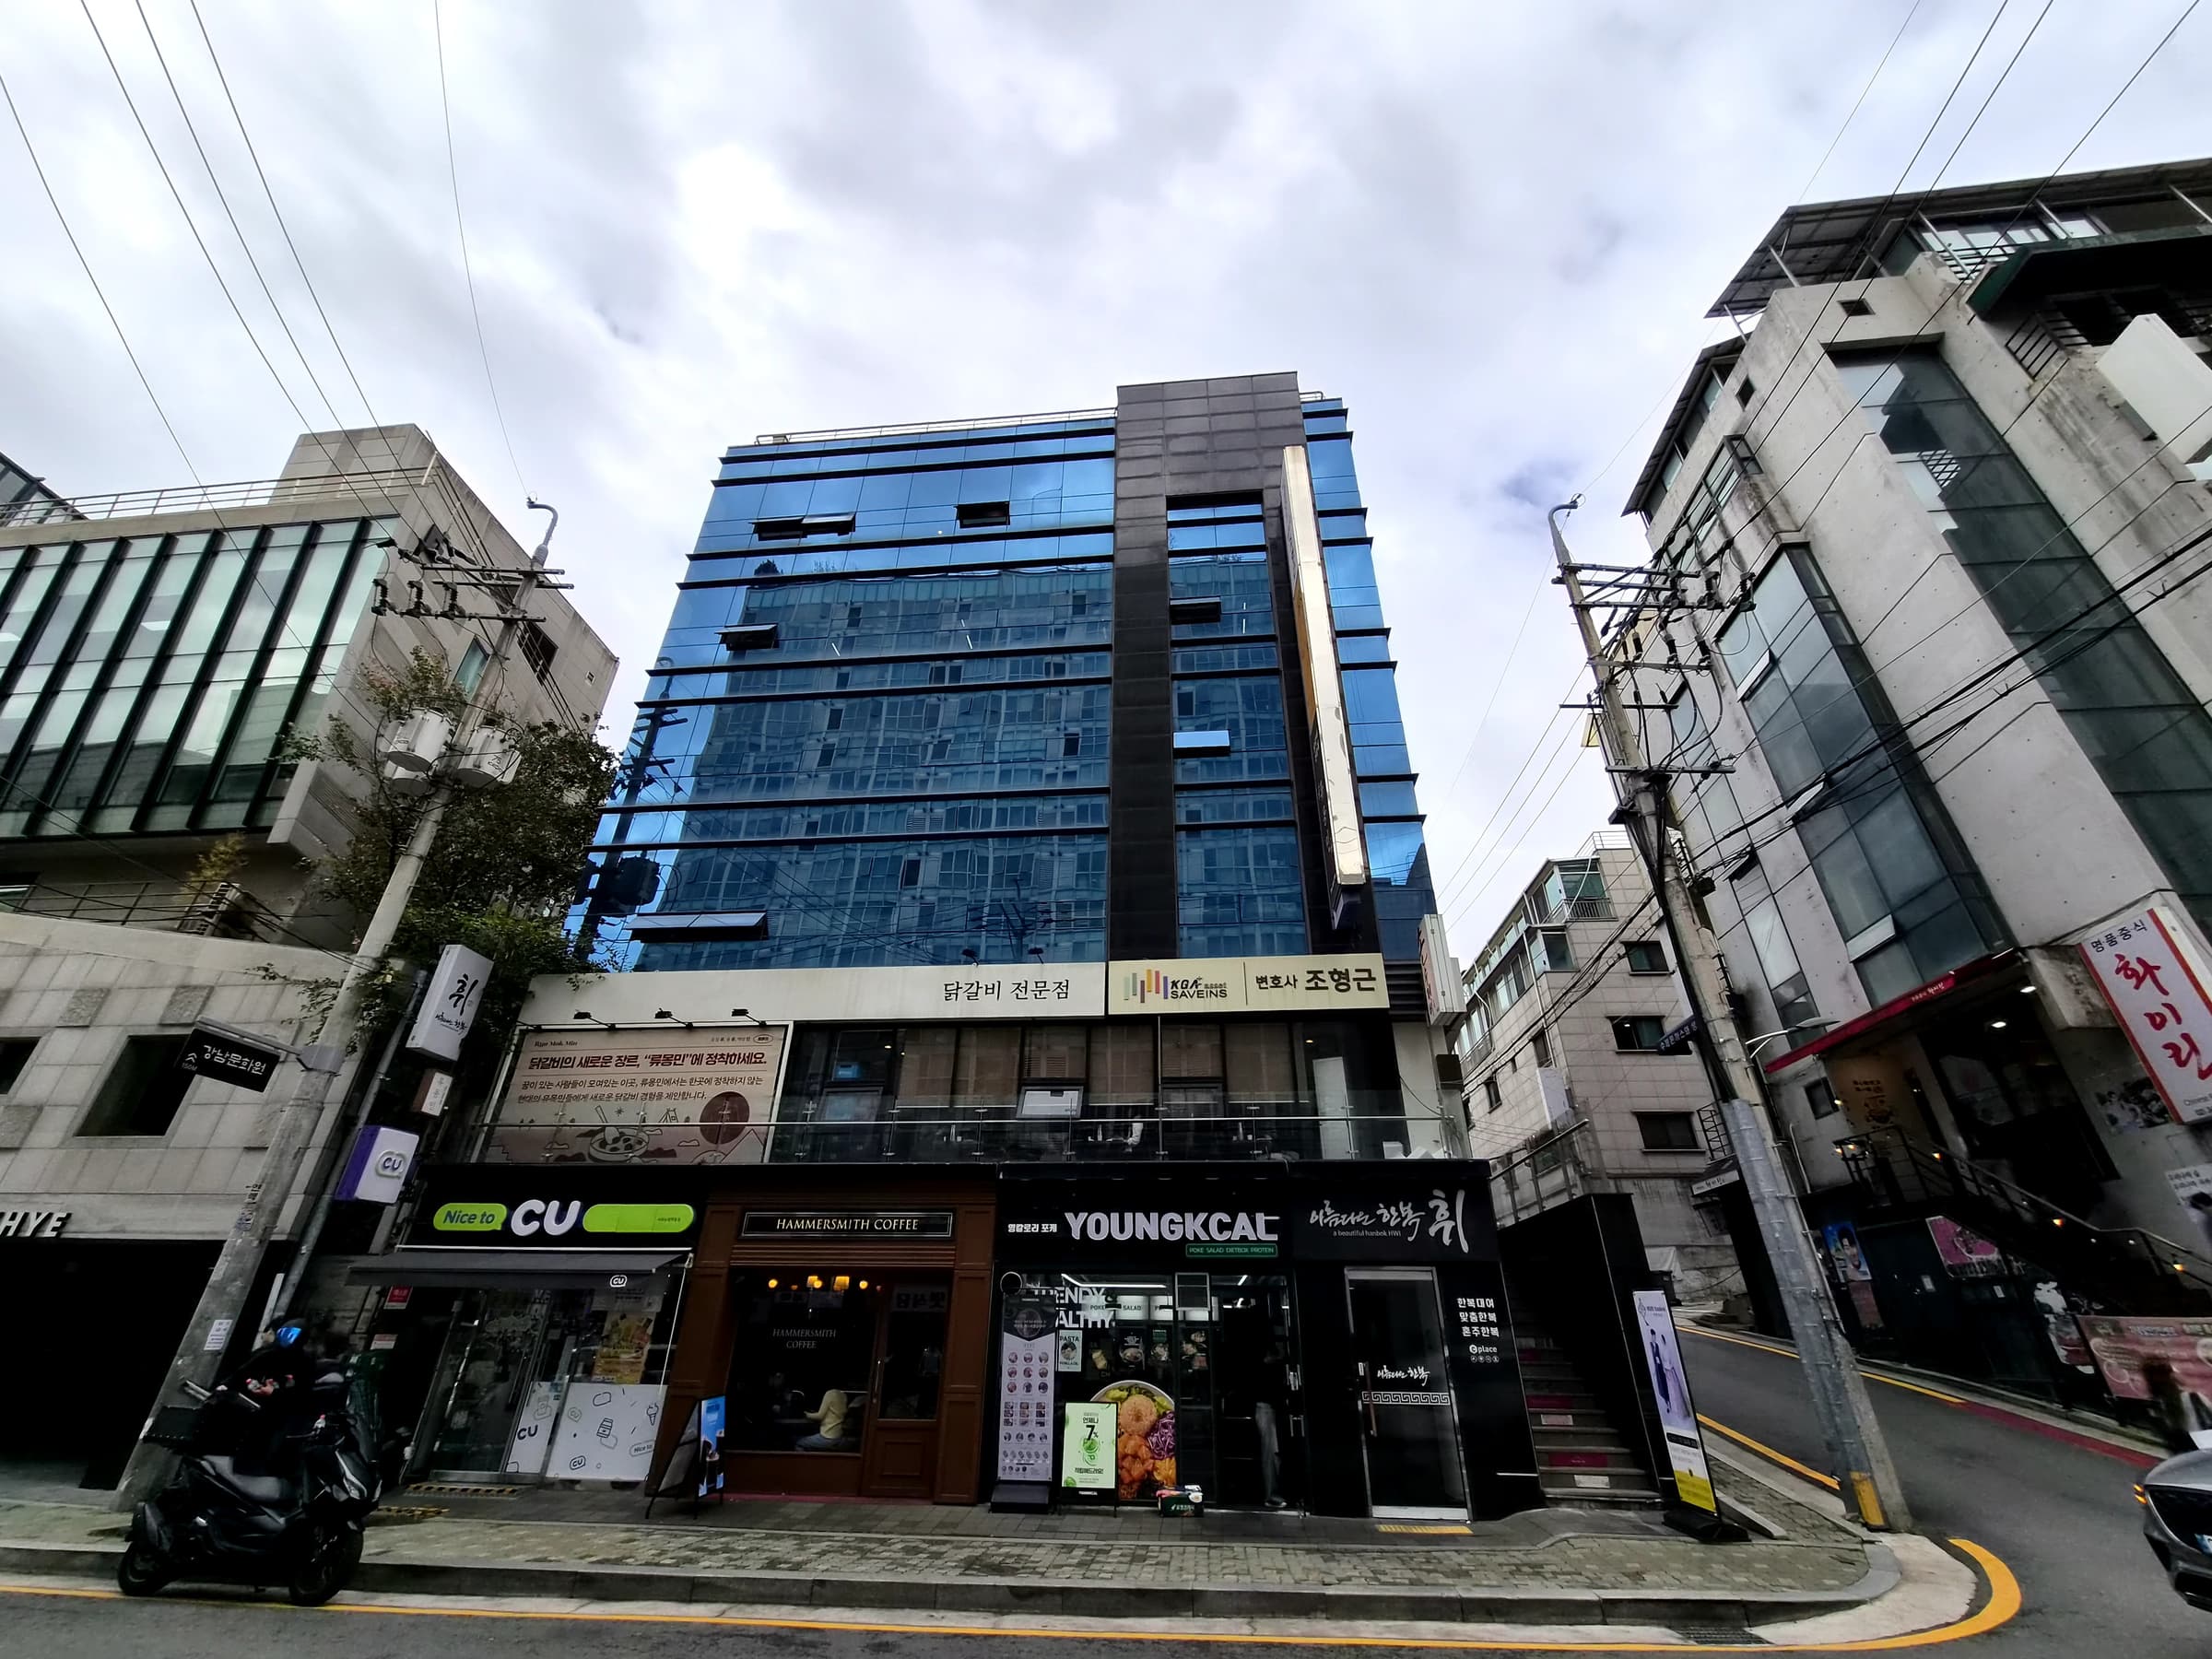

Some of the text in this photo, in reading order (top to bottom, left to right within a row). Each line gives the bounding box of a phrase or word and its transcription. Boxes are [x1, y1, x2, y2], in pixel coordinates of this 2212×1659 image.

[1255, 969, 1376, 994] 변호사 조형근
[449, 973, 478, 1017] 휘
[944, 979, 1070, 1002] 닭갈비 전문점
[1171, 989, 1228, 1000] SAVEINS
[203, 1044, 266, 1076] 강남문화원
[528, 1056, 576, 1069] 닭갈비의
[576, 1055, 613, 1068] 새로운
[615, 1054, 640, 1068] 장르,
[705, 1052, 767, 1065] 정착하세요.
[539, 1080, 554, 1089] 있는
[555, 1079, 587, 1088] 사람들이
[587, 1078, 619, 1088] 모여있는
[688, 1077, 712, 1087] 한곳에
[714, 1076, 746, 1086] 정착하지
[747, 1076, 764, 1085] 않는
[591, 1093, 614, 1102] 새로운
[615, 1092, 639, 1101] 닭갈비
[665, 1090, 707, 1101] 제안합니다.
[382, 1157, 403, 1171] CU
[0, 1212, 67, 1237] HYE
[442, 1209, 495, 1225] Nice to
[511, 1199, 582, 1236] CU
[776, 1218, 919, 1230] HAMMERSMITH COFFEE
[1309, 1200, 1427, 1241] 아름다운 한복
[1429, 1189, 1469, 1253] 휘
[1041, 1223, 1058, 1233] 포케
[1065, 1212, 1280, 1241] YOUNGKCAL
[612, 1277, 625, 1286] CU
[1456, 1298, 1495, 1309] 한복대여
[1055, 1310, 1113, 1328] ALTHY
[1459, 1312, 1497, 1324] 맞춤한복
[772, 1328, 836, 1338] HAMMERSMITH
[1461, 1326, 1500, 1337] 혼주한복
[786, 1341, 817, 1349] COFFEE
[516, 1425, 539, 1441] CU
[571, 1459, 582, 1467] CU
